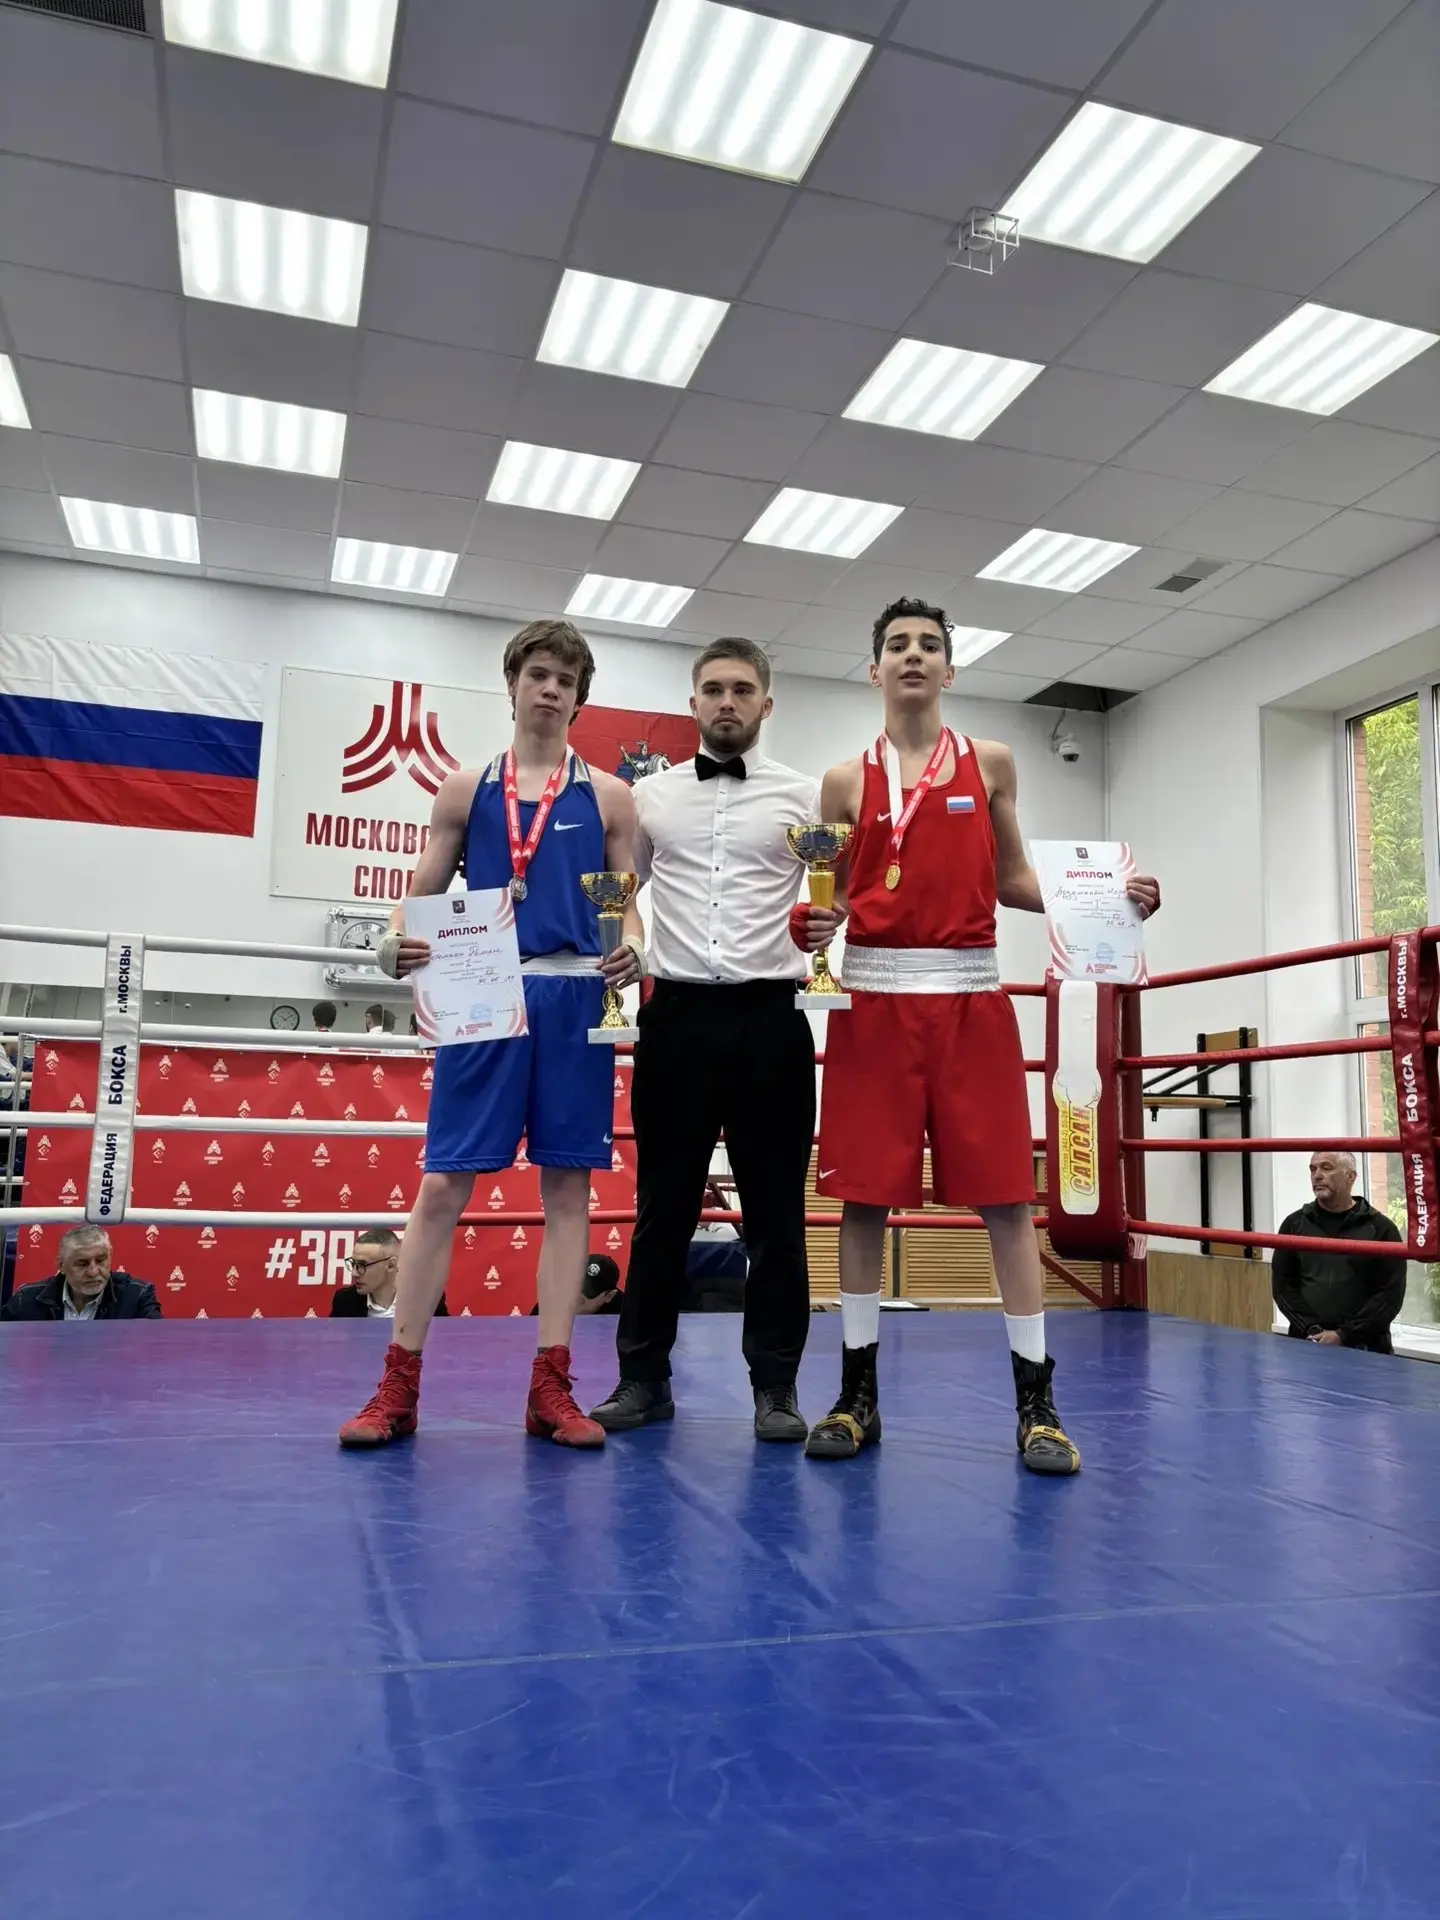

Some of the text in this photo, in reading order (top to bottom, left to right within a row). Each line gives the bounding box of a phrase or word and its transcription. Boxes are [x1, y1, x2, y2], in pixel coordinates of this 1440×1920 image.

[1065, 870, 1113, 879] ДИПЛОМ
[437, 925, 488, 939] ДИПЛОМ
[99, 945, 132, 1216] ФЕДЕРАЦИЯ БОКСА г.МОСКВЫ
[1397, 940, 1427, 1247] ФЕДЕРАЦИЯ БОКСА г.МОСКВЫ
[1072, 1106, 1093, 1192] САПСАН
[264, 1230, 404, 1285] #ЗА
